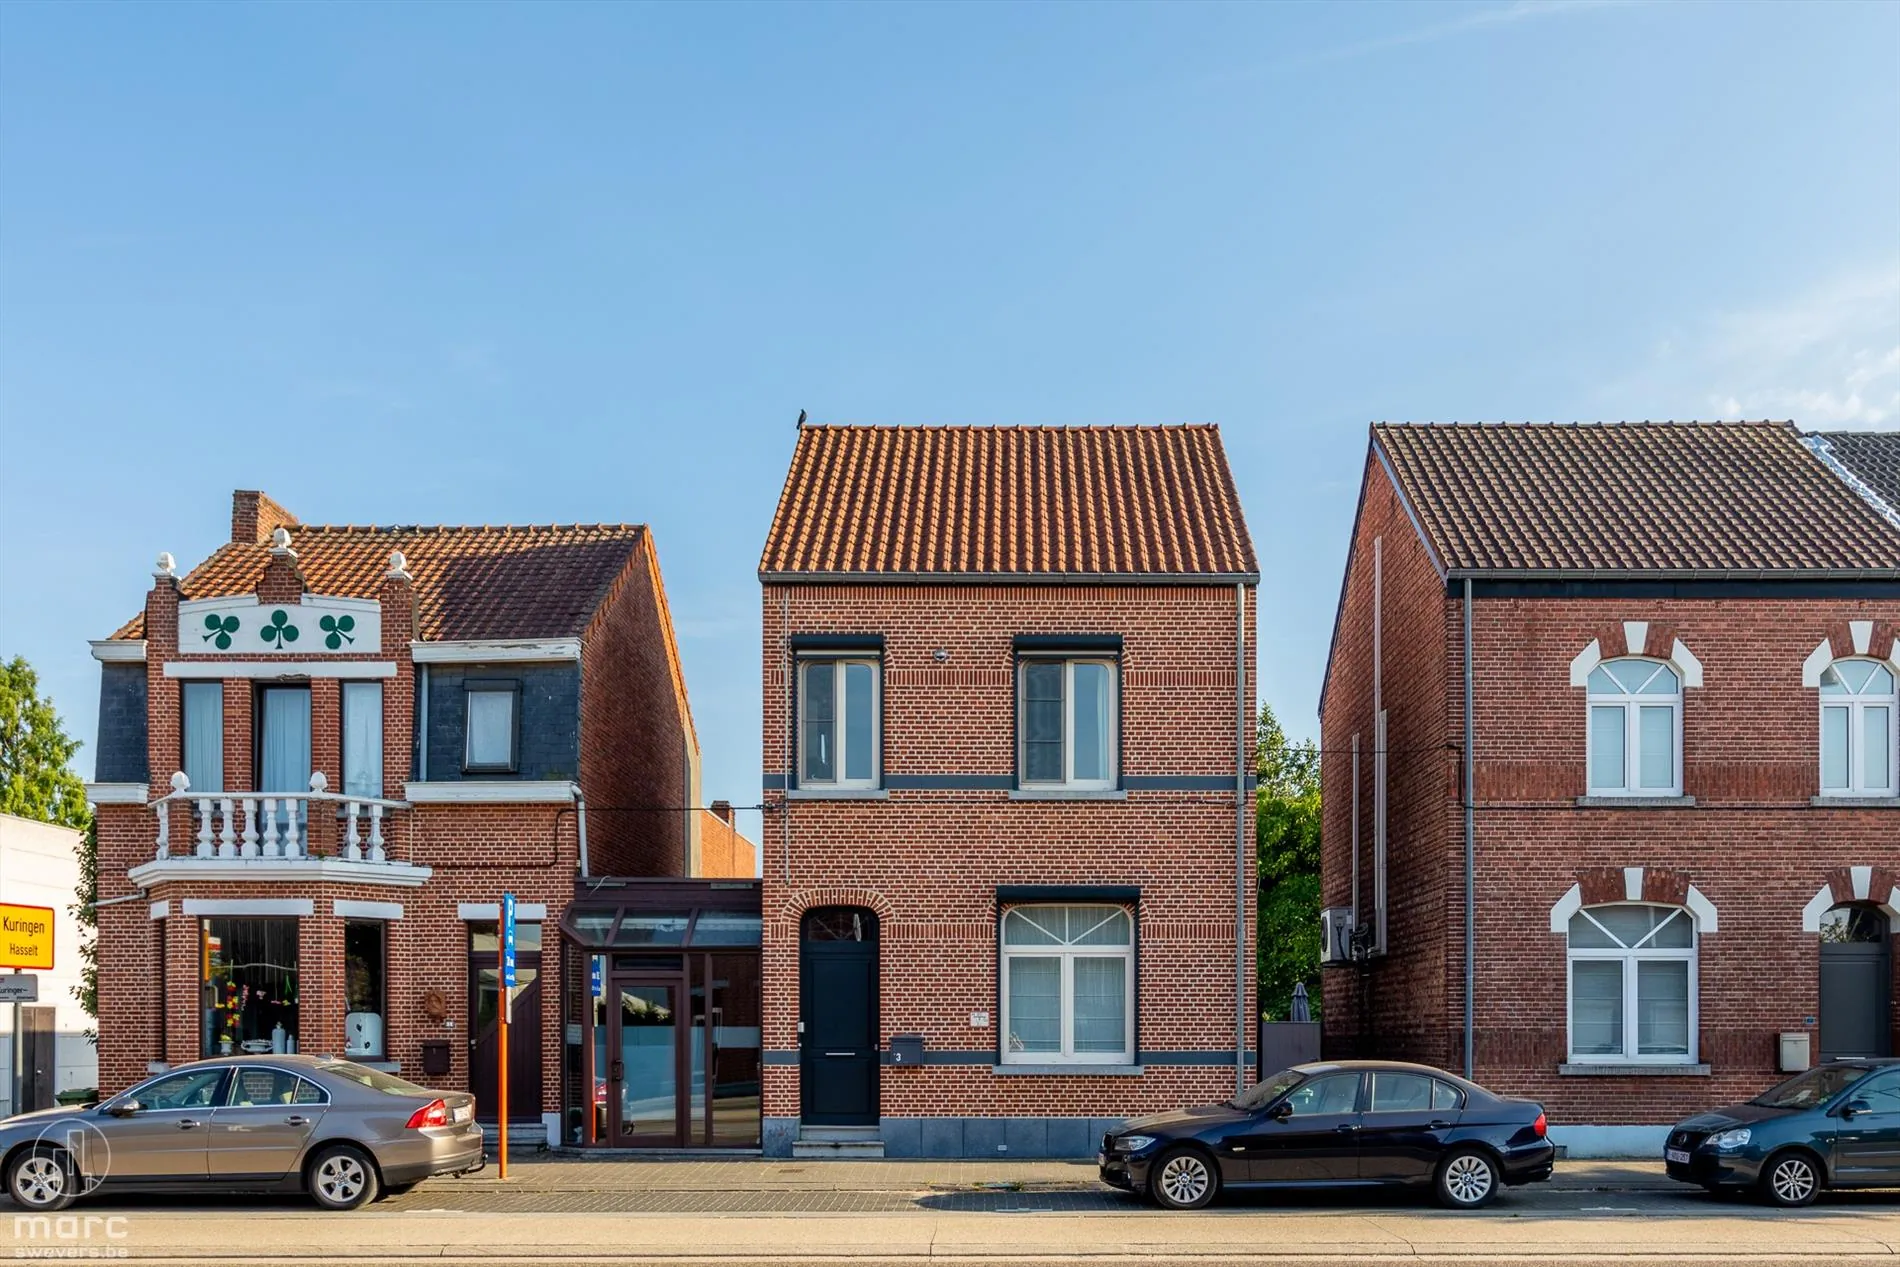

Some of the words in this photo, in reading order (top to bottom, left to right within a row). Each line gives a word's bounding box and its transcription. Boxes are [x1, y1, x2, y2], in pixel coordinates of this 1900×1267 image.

[3, 916, 45, 936] Kuringen
[9, 942, 38, 956] Hasselt
[896, 1052, 902, 1062] 3
